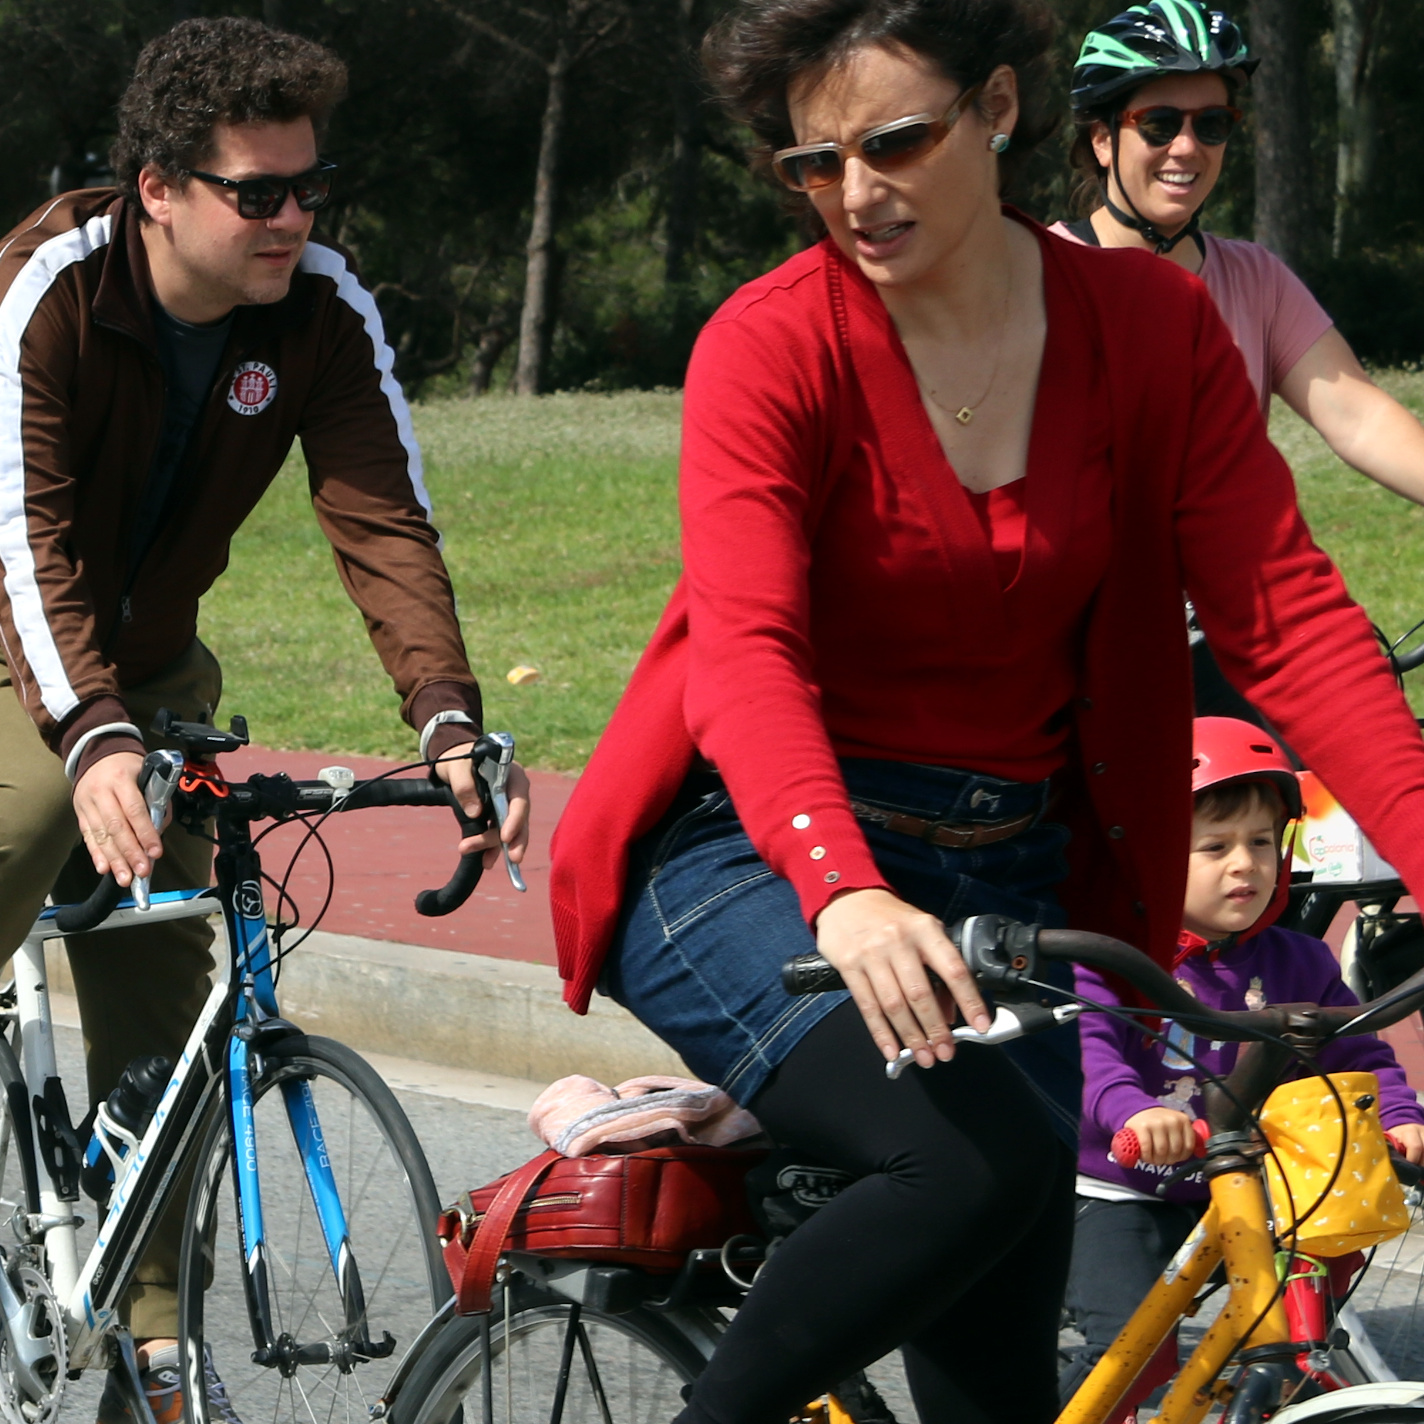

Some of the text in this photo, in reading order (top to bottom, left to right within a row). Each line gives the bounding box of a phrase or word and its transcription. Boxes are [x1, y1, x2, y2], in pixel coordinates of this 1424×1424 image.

[253, 361, 277, 389] PAULI
[238, 404, 259, 414] 1910
[243, 1124, 258, 1172] 4900
